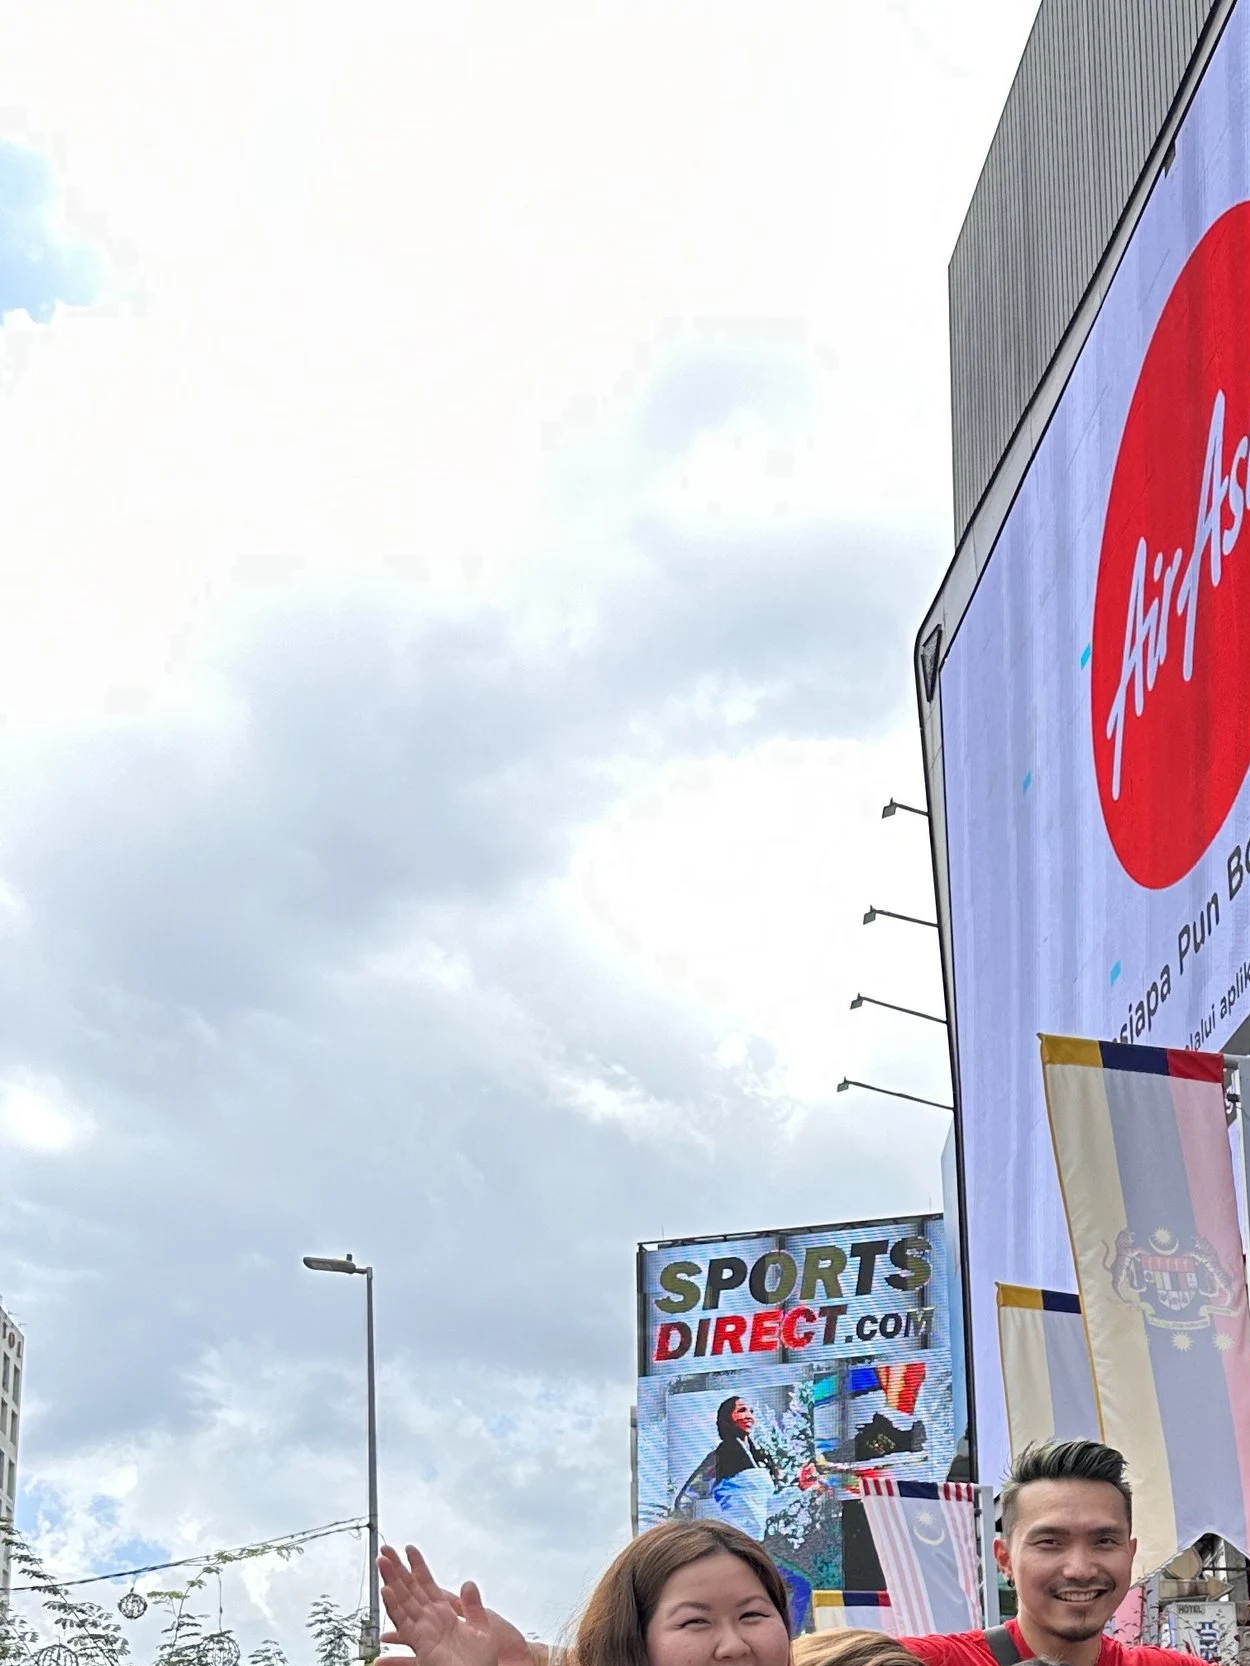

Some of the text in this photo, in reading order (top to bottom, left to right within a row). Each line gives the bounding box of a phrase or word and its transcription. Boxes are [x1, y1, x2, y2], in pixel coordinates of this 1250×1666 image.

[1112, 964, 1171, 1043] siapa
[1178, 897, 1220, 975] Pun
[1185, 1004, 1216, 1052] lalui
[654, 1236, 933, 1314] SPORTS
[653, 1304, 935, 1363] DIRECT.COM
